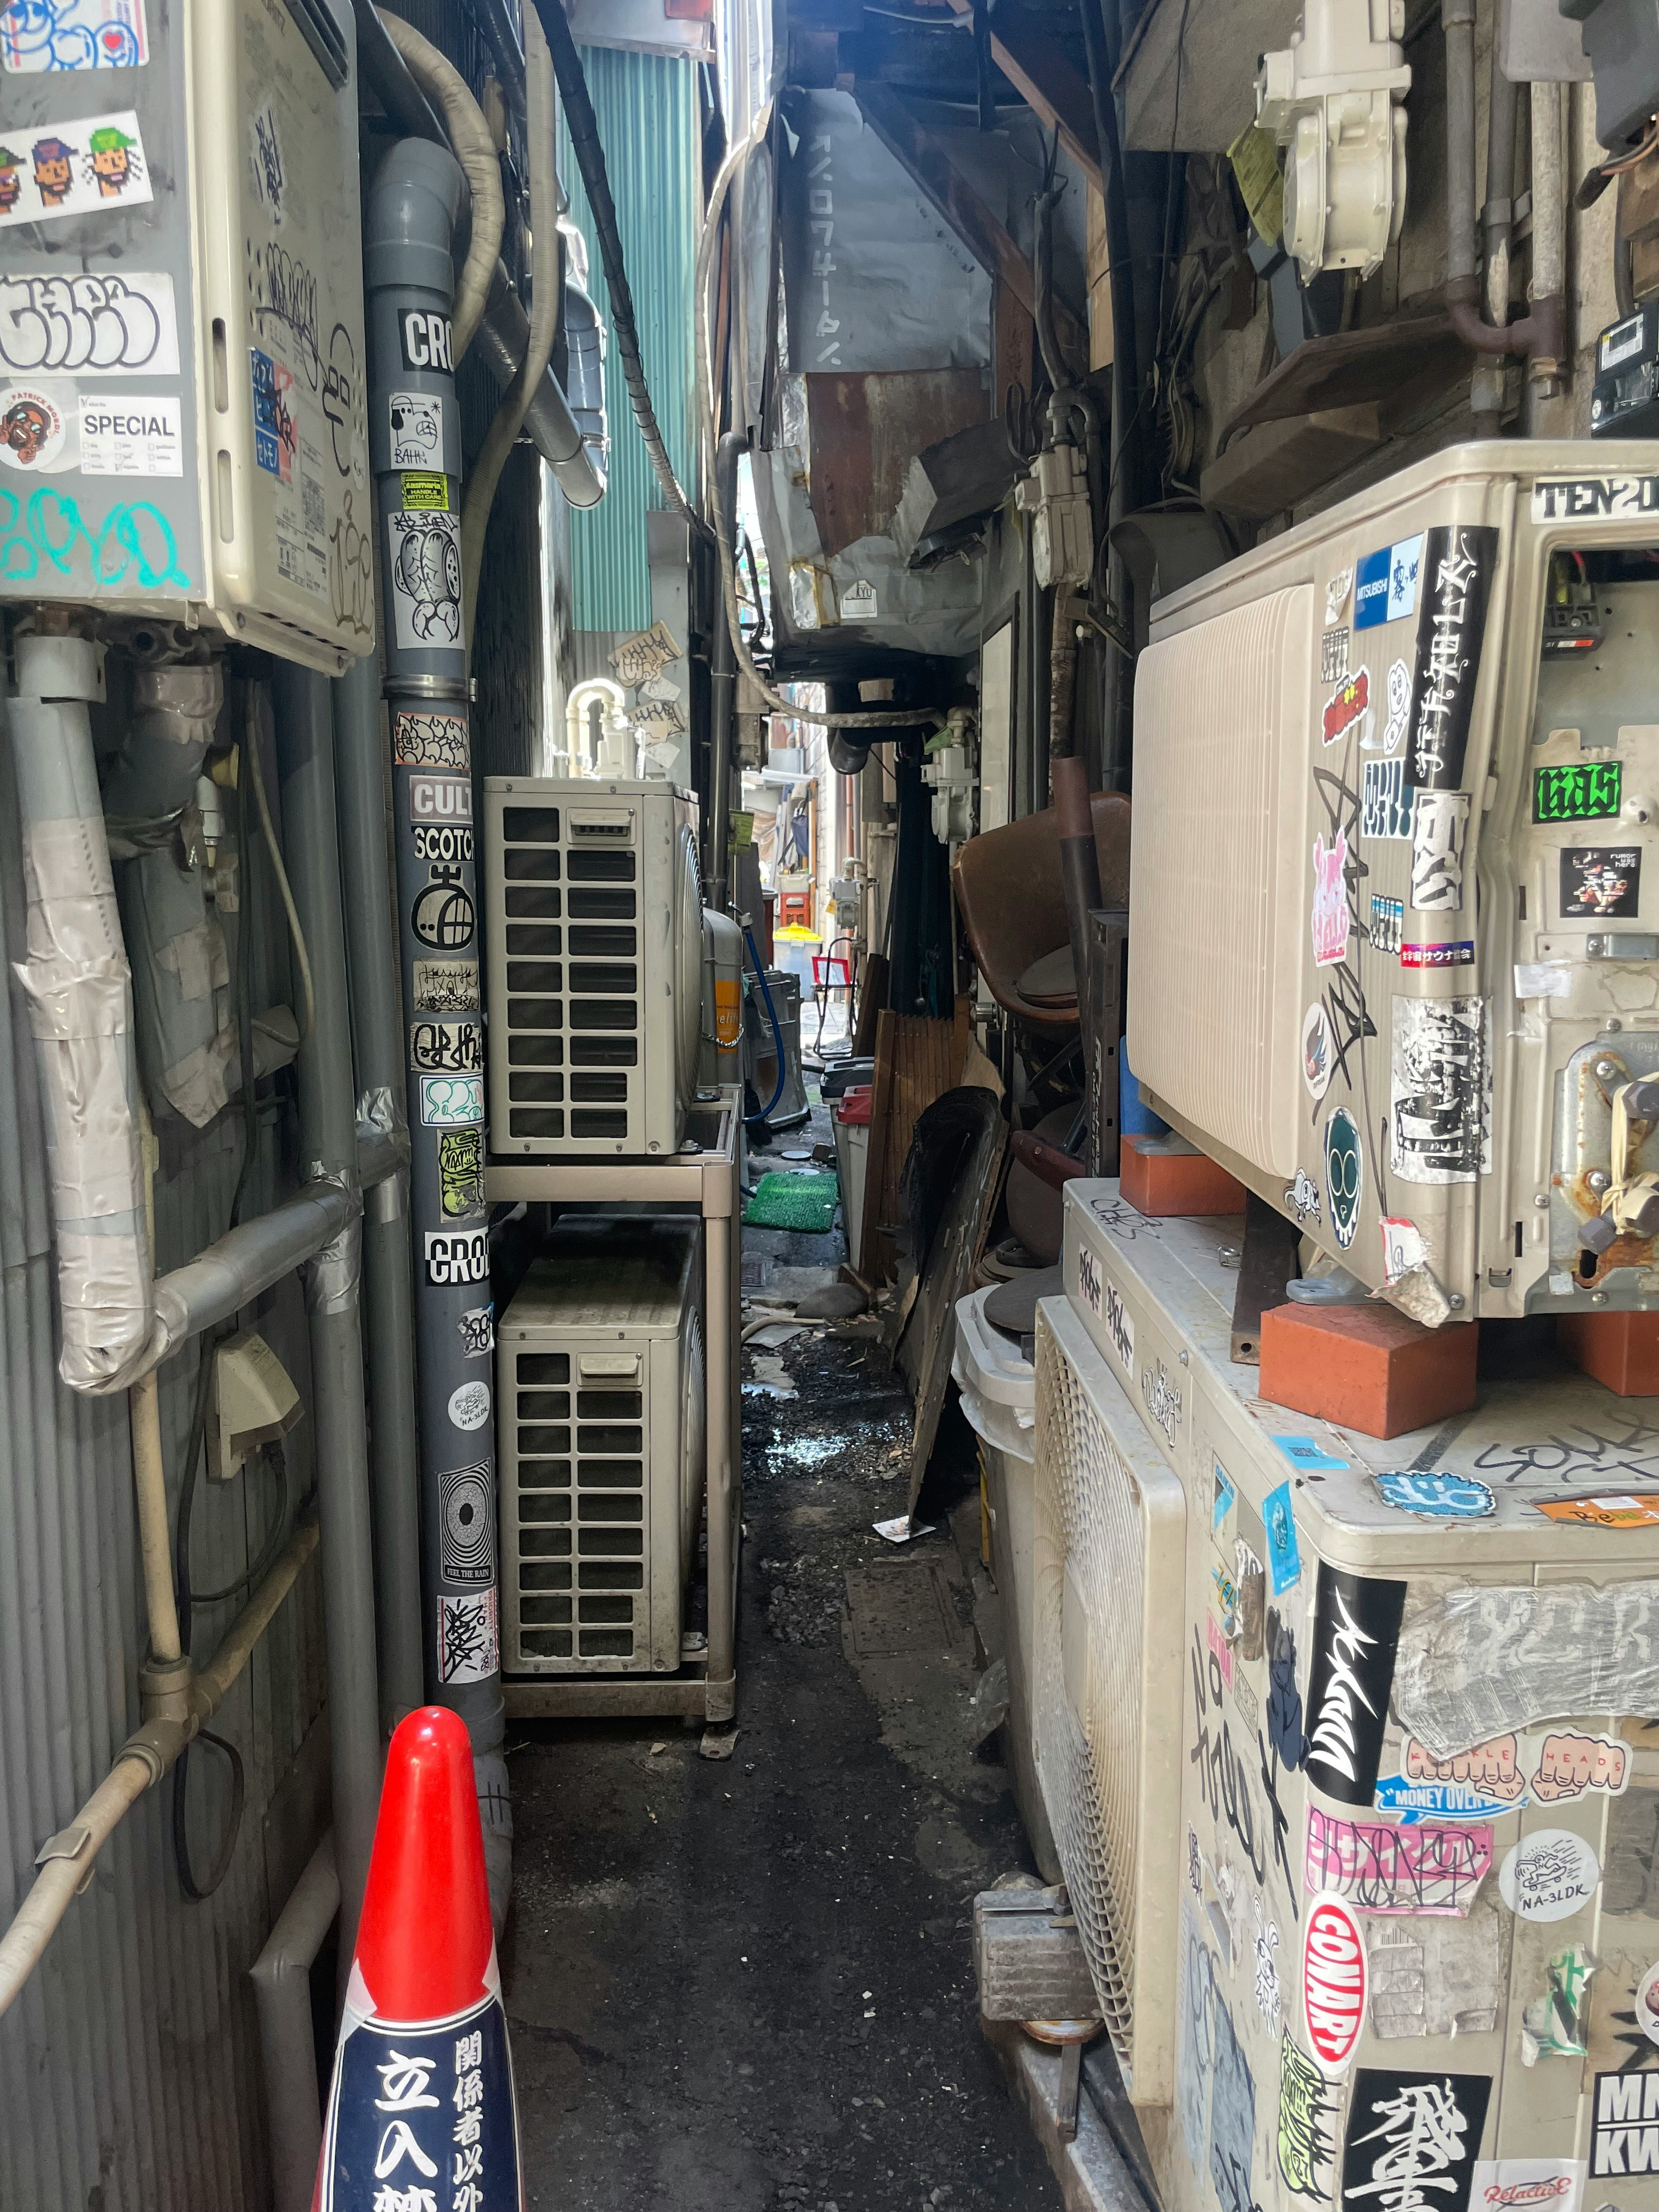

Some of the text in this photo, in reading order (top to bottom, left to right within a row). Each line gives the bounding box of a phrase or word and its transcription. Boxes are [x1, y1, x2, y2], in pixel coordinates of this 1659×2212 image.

[84, 415, 175, 437] SPECIAL
[1356, 577, 1388, 602] MITSUBISHI
[447, 1567, 489, 1578] FEEL THE RAIN
[1307, 1914, 1361, 2055] CONART
[453, 2030, 484, 2212] 関係者以外
